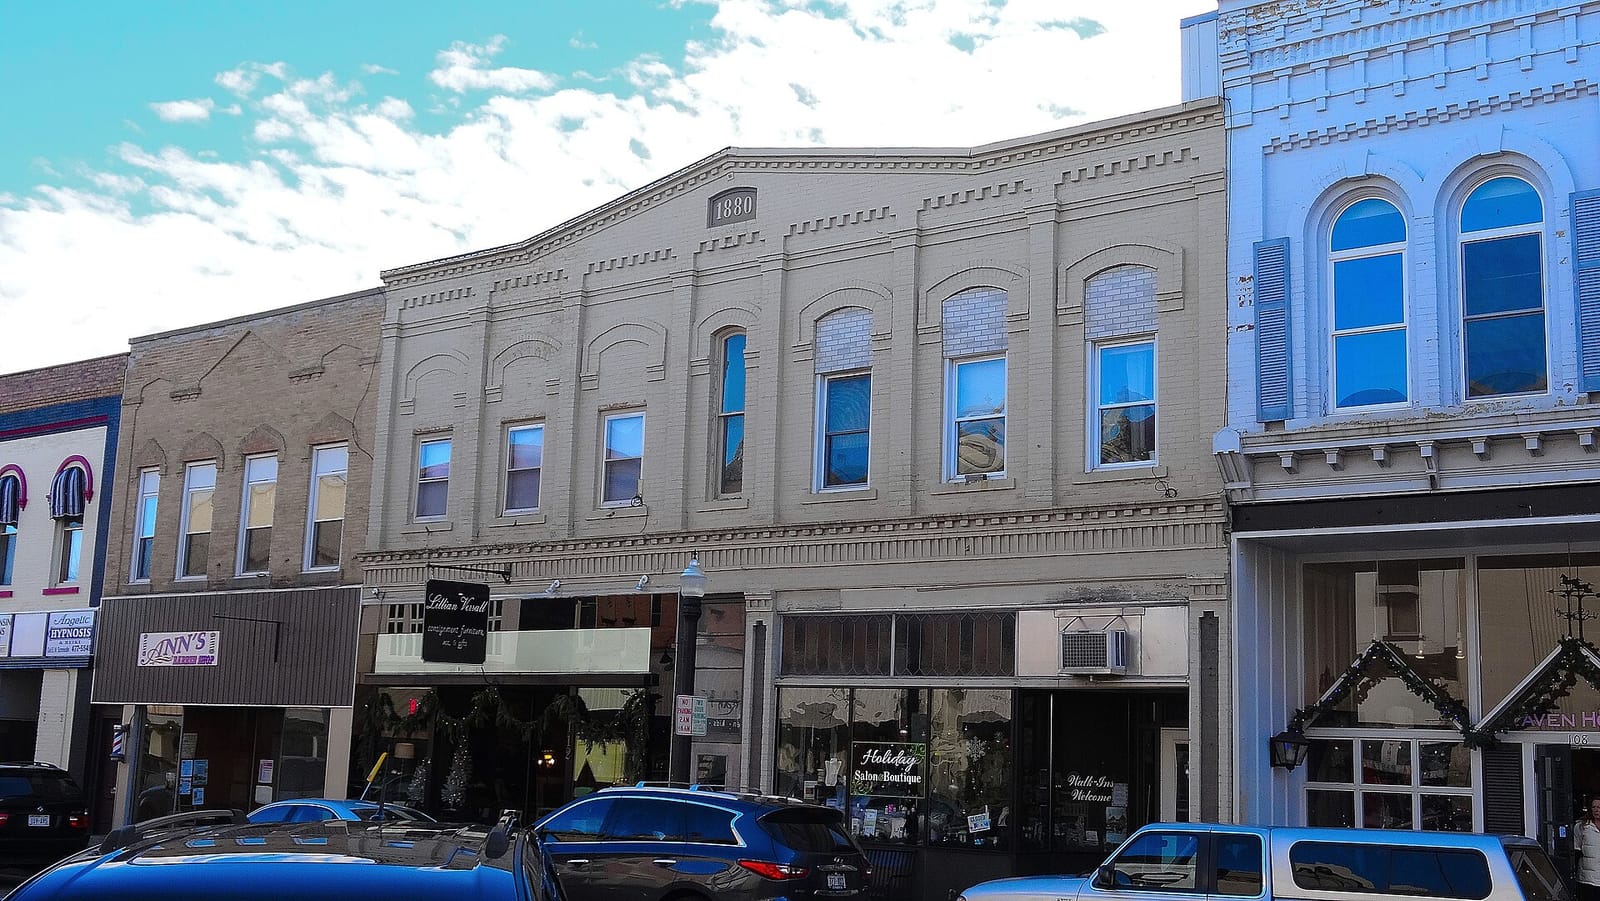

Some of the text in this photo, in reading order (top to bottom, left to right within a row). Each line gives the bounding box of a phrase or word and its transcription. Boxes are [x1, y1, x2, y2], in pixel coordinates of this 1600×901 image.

[715, 196, 752, 220] 1880
[426, 592, 458, 611] Lillian
[54, 614, 91, 627] Angelic
[51, 628, 91, 638] HYPNOSIS
[141, 632, 207, 665] ANN'S
[1568, 734, 1588, 745] 108
[860, 748, 918, 772] Holiday
[854, 769, 878, 781] Salon
[883, 771, 922, 785] Boutique
[1067, 774, 1114, 788] Walk-Ins
[1071, 789, 1112, 802] Welcome
